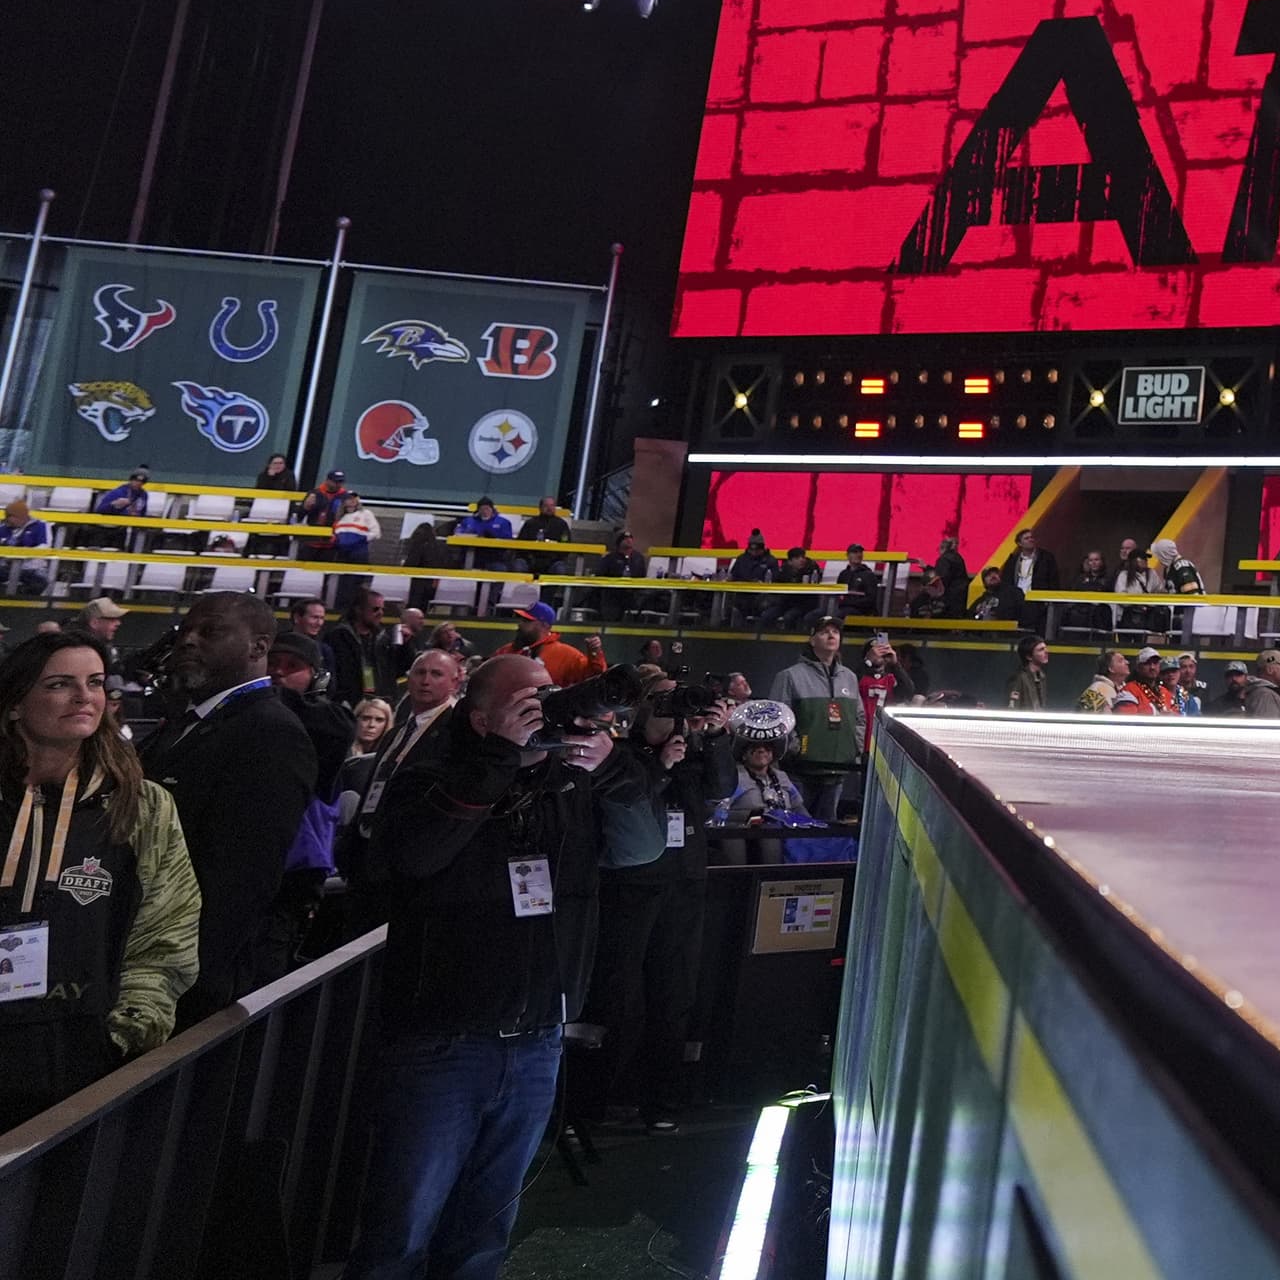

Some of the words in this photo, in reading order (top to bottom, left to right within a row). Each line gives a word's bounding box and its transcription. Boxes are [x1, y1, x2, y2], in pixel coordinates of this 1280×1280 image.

[1136, 373, 1190, 396] BUD
[1124, 395, 1198, 419] LIGHT
[63, 876, 109, 891] DRAFT
[47, 981, 90, 1000] AY
